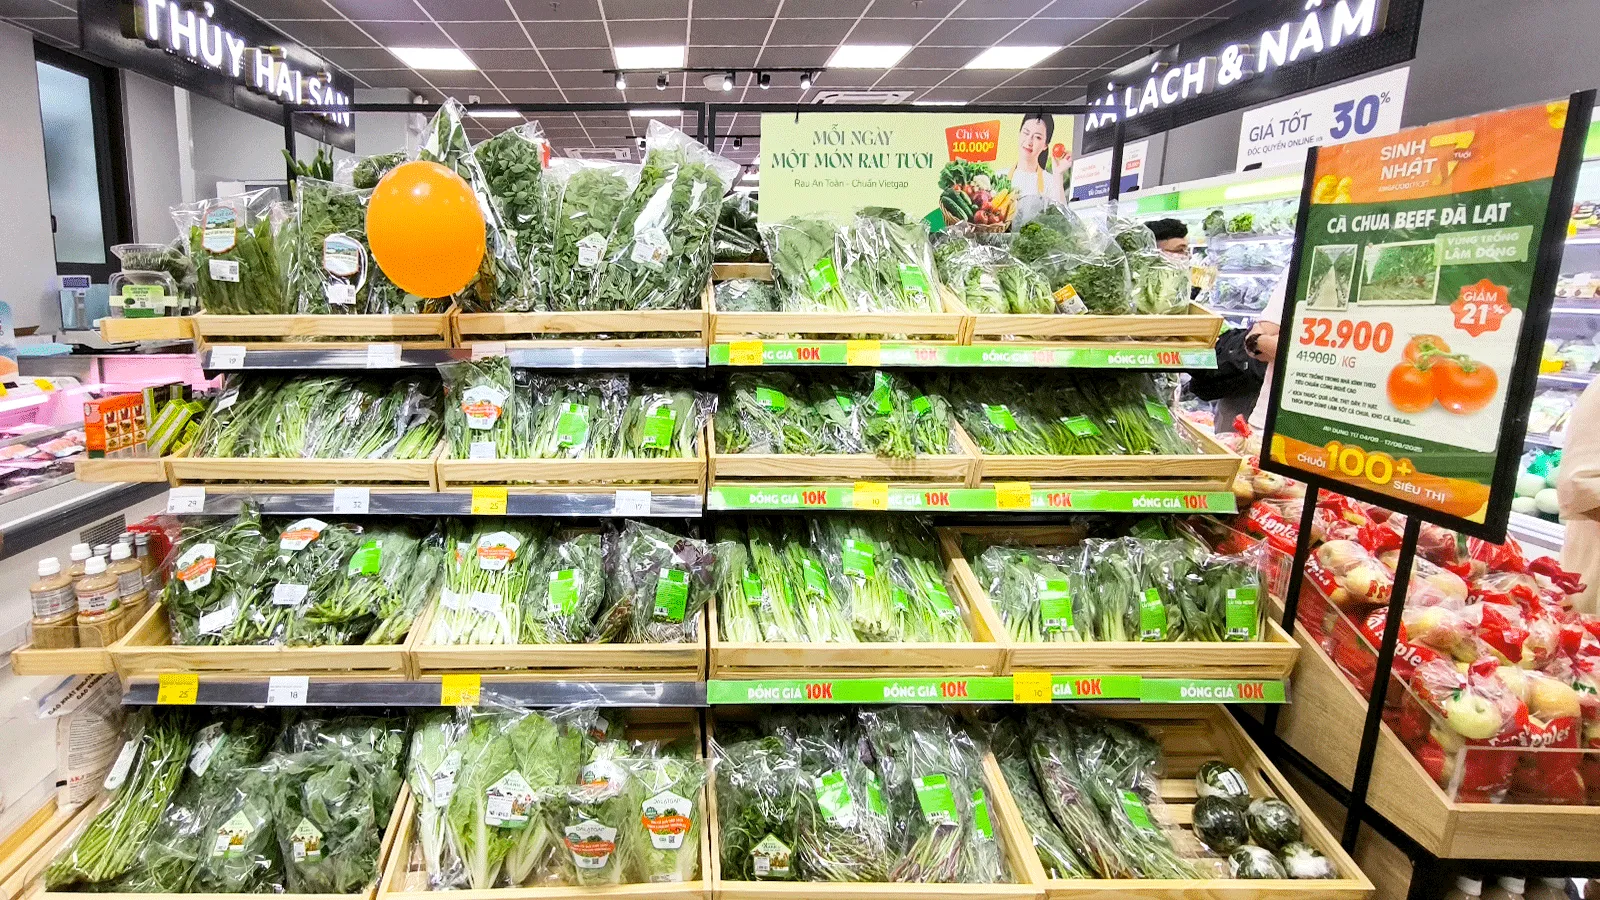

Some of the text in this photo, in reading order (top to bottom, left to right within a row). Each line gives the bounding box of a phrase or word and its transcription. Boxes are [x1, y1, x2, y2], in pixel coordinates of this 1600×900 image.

[147, 0, 245, 78] THỦY
[1125, 56, 1207, 118] LÁCH
[1217, 44, 1244, 86] &
[1249, 109, 1313, 142] GIÁ TỐT
[812, 124, 893, 147] MỖI NGÀY
[974, 129, 990, 140] với
[1287, 135, 1315, 148] ONLINE
[1379, 138, 1427, 161] SINH
[771, 150, 934, 174] MỘT MÓN RAU TƯƠI
[1380, 157, 1439, 181] NHẬT
[794, 179, 810, 188] Rau
[811, 179, 824, 188] An
[825, 179, 844, 188] Toàn
[878, 179, 909, 189] Vietgap
[1327, 202, 1512, 233] CÀ CHUA BEEF ĐÀ LẠT
[1444, 247, 1472, 260] LÂM
[1299, 317, 1394, 354] 32.900
[796, 347, 820, 360] 10K
[914, 348, 938, 361] 10K
[1032, 350, 1056, 363] 10K
[1108, 352, 1181, 365] ĐỒNG GIÁ 10K
[749, 491, 827, 505] ĐỒNG GIÁ 10K
[924, 492, 950, 506] 10K
[1393, 479, 1446, 504] SIÊU THỊ
[1047, 493, 1072, 507] 10K
[1132, 494, 1208, 508] ĐỒNG GIÁ 10K
[289, 690, 299, 699] 18
[747, 683, 833, 699] ĐỒNG GIÁ 10K
[883, 681, 968, 697] ĐỒNG GIÁ 10K
[1033, 689, 1043, 697] 10
[1052, 679, 1102, 696] GIÁ 10K
[1180, 683, 1264, 699] ĐỒNG GIÁ 10K
